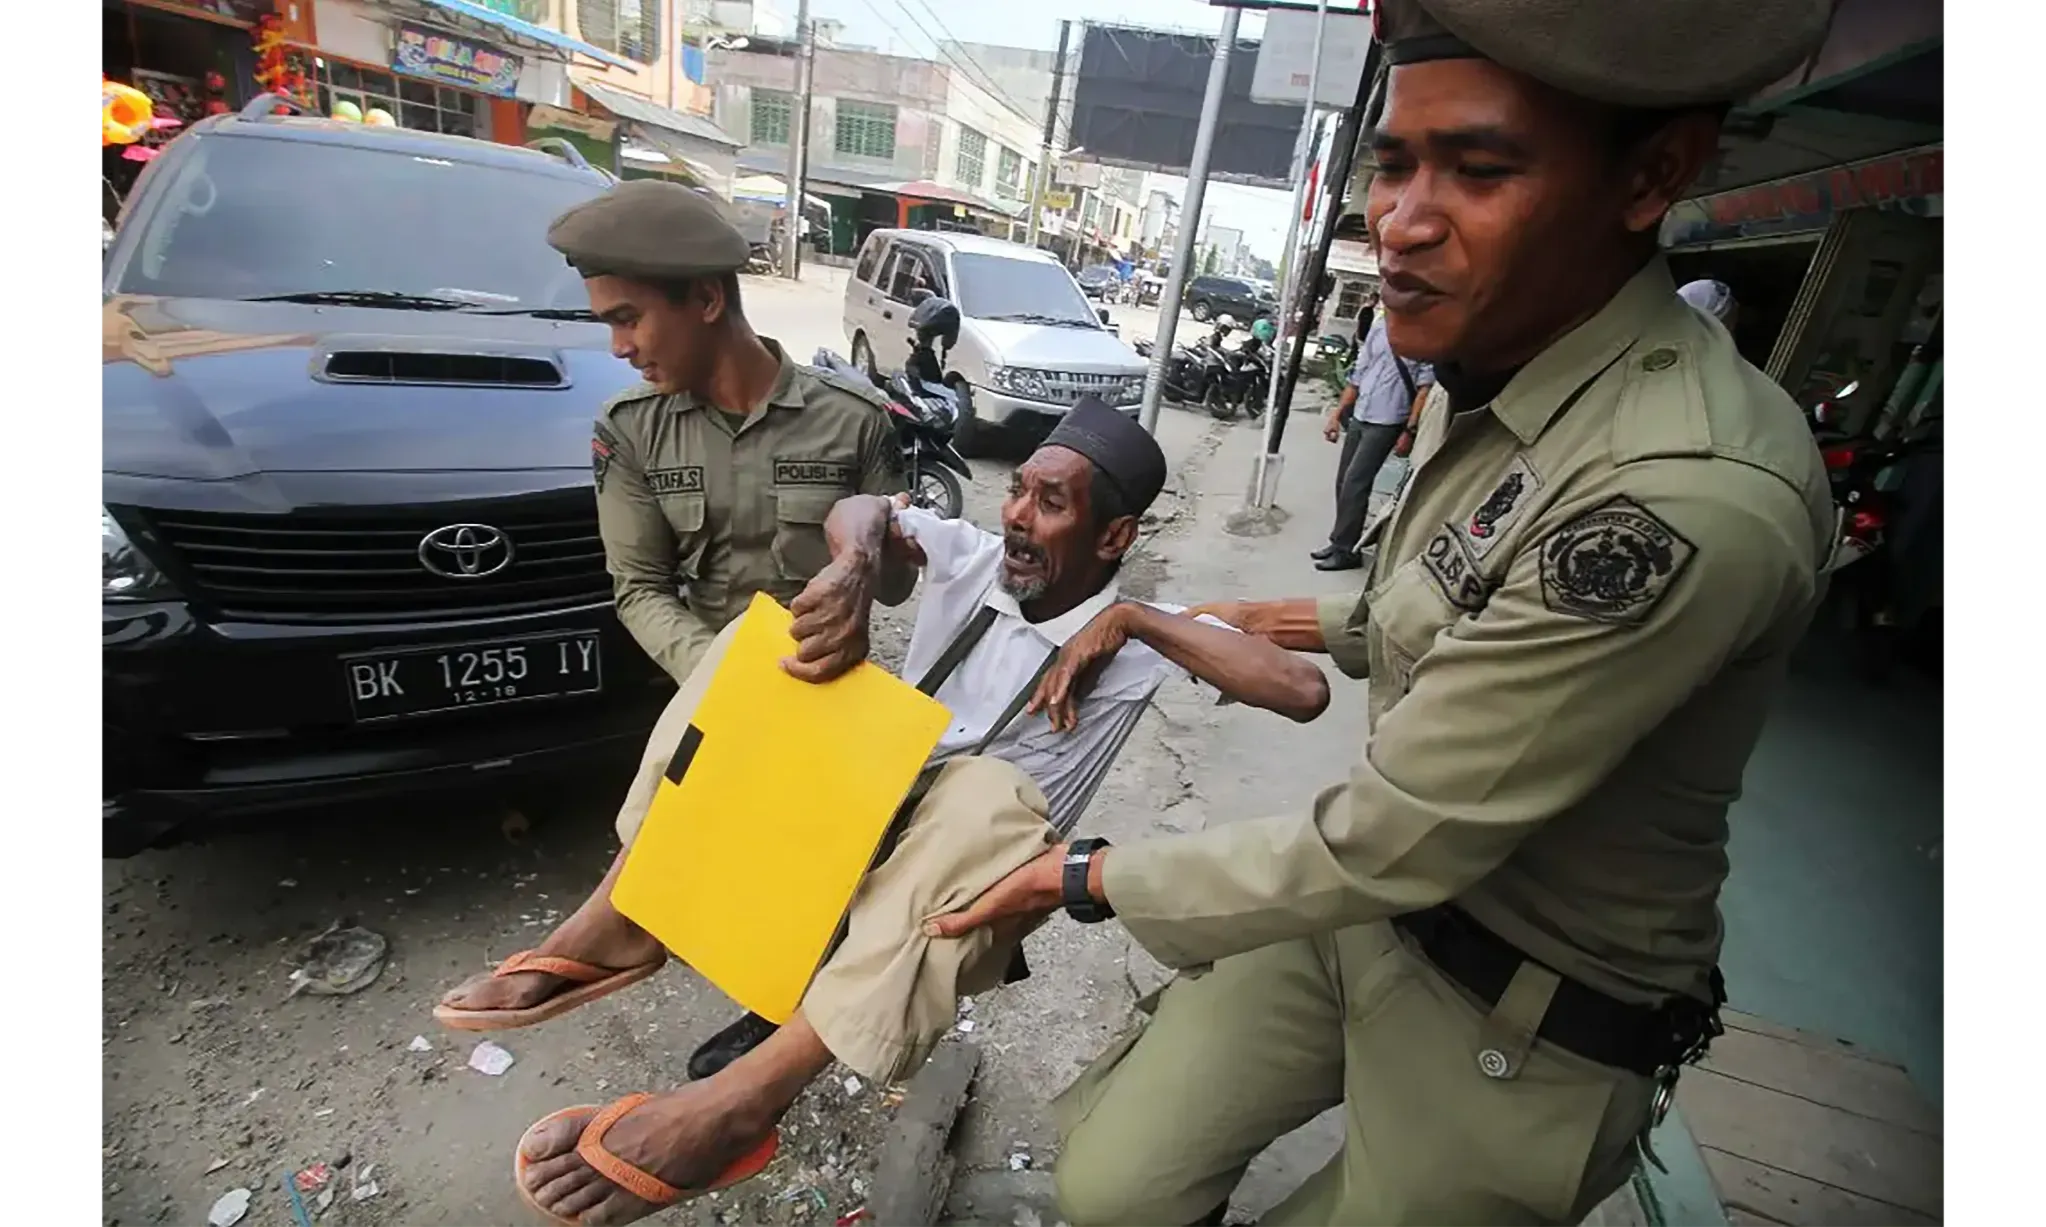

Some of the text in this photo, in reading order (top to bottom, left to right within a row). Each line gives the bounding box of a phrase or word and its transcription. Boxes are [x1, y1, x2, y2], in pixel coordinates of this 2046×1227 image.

[645, 470, 698, 490] STAFA.S
[352, 640, 593, 700] BK 1255 IY
[454, 685, 516, 702] 12-18
